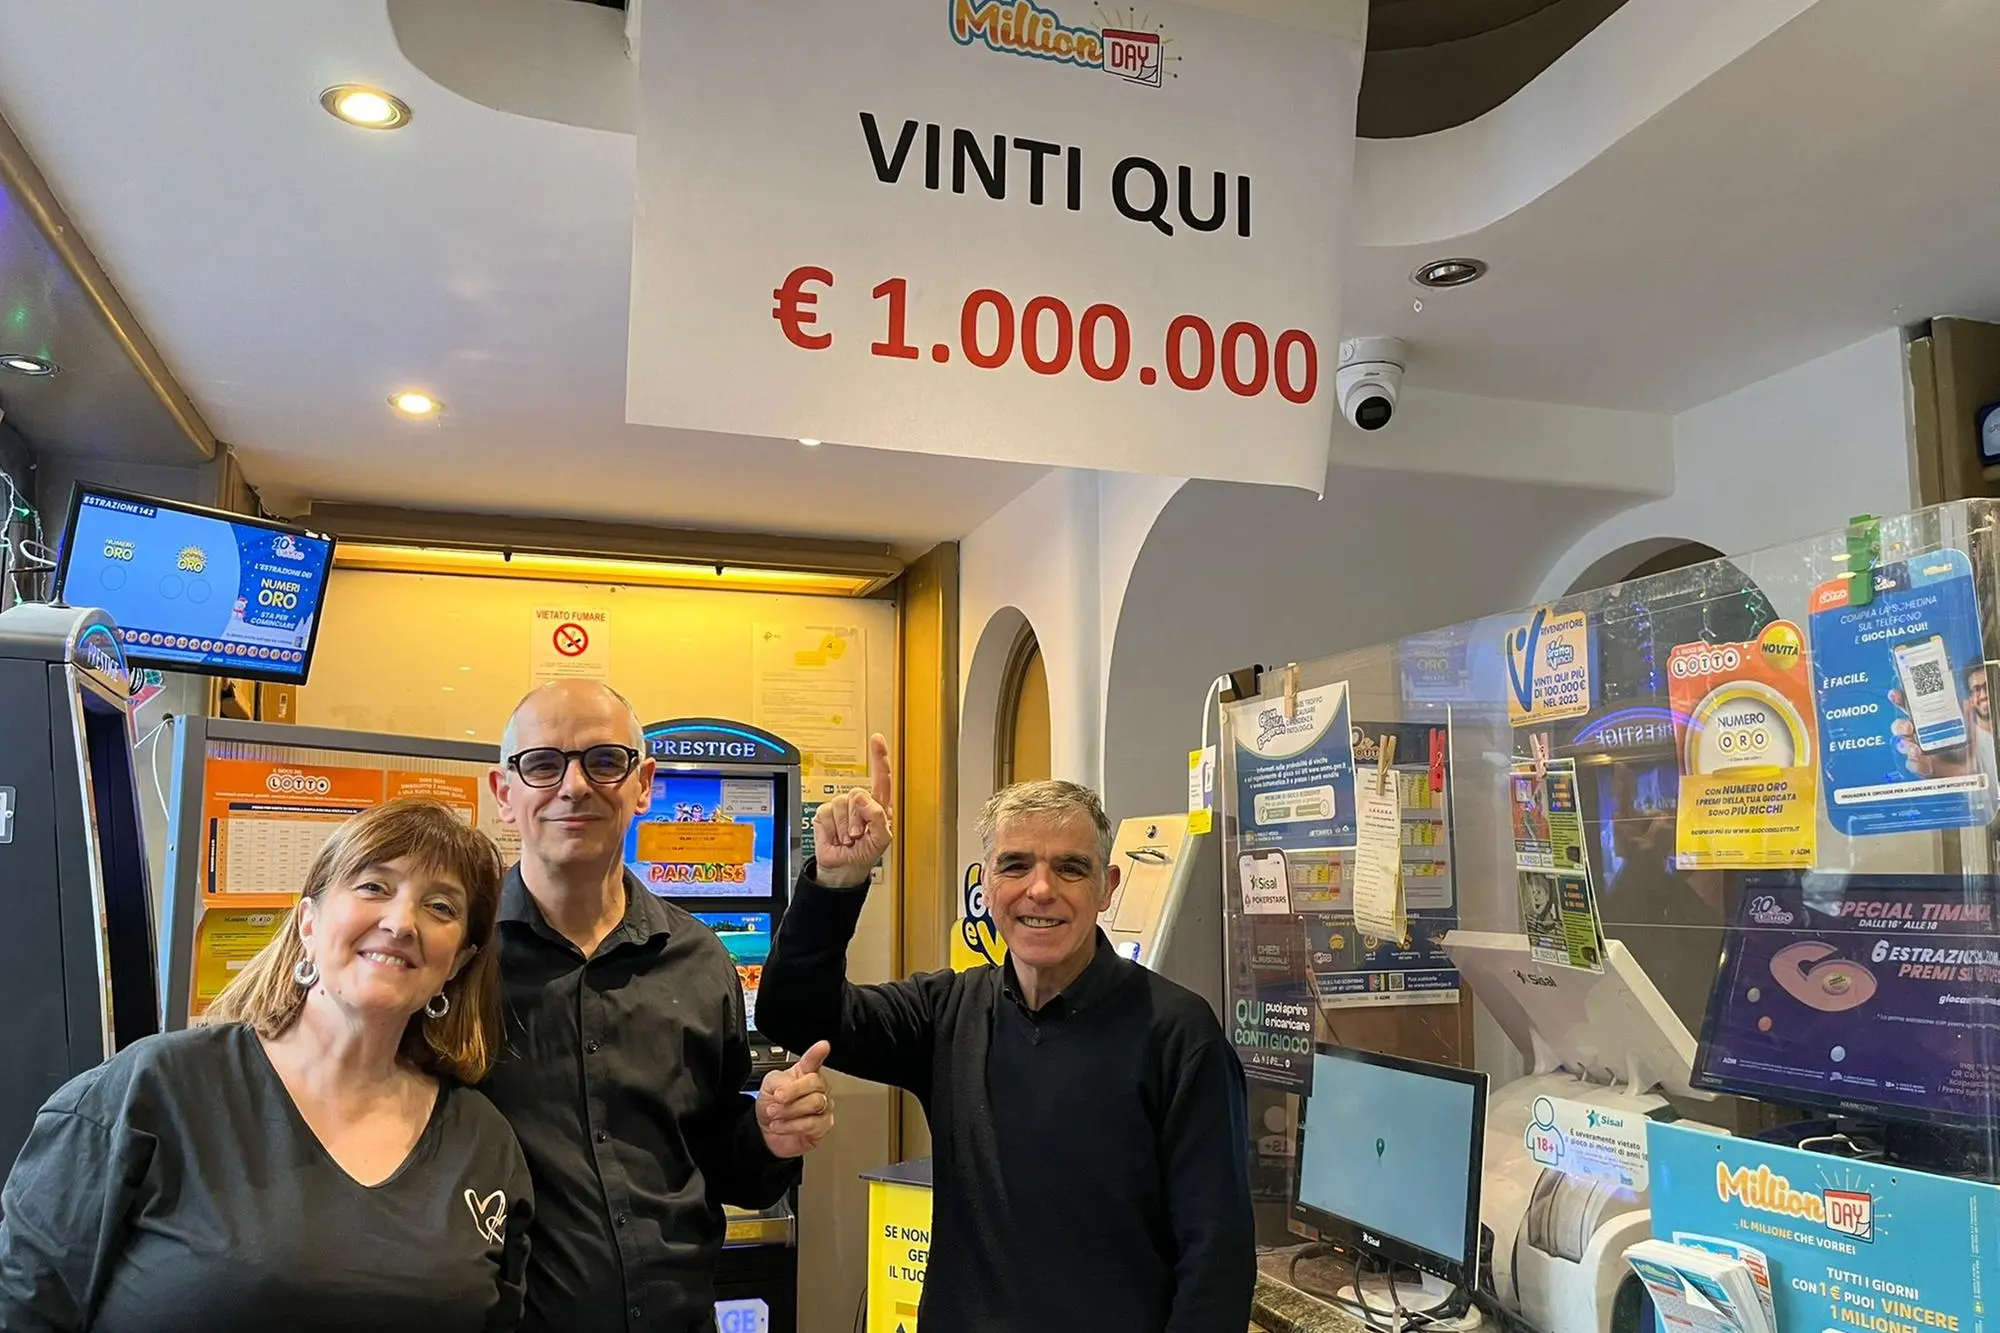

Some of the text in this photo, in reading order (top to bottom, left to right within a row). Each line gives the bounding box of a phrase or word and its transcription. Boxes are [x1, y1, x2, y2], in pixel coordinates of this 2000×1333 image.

[952, 0, 1149, 71] Million DAY
[860, 112, 1252, 238] VINTI QUI
[773, 266, 1318, 405] € 1.000.000
[83, 496, 154, 516] ESTRAZIONE 142
[104, 545, 133, 561] ORO
[178, 560, 203, 573] ORO
[255, 563, 301, 577] L'ESTRAZIONE
[261, 578, 301, 592] NUMERI
[258, 589, 297, 609] ORO
[536, 611, 606, 621] VIETATO FUMARE
[1840, 595, 1937, 625] COMPILA LA SCHEDINA
[250, 618, 296, 630] COMINCIARE
[1541, 619, 1583, 635] RIVENDITORE
[1858, 611, 1922, 632] SUL TELEFONO
[1861, 626, 1906, 642] GIOCALA
[1906, 621, 1929, 634] QUI!
[1761, 641, 1799, 656] NOVITÀ
[88, 642, 119, 682] PRESTIGE
[1673, 650, 1738, 676] LOTTO
[1534, 666, 1585, 687] VINTI QUI PIÙ
[1830, 672, 1869, 688] FACILE,
[1535, 680, 1586, 698] DI 100.000 €
[1544, 694, 1578, 708] NEL 2023
[1718, 712, 1765, 728] NUMERO
[1826, 703, 1878, 720] COMODO
[652, 739, 756, 757] PRESTIGE
[1720, 731, 1767, 752] ORO
[1829, 735, 1885, 752] E VELOCE.
[268, 775, 329, 793] LOTTO
[1705, 781, 1788, 796] CON NUMERO ORO
[1699, 798, 1720, 806] PREMI
[1722, 797, 1744, 805] DELLA
[1746, 796, 1760, 804] TUA
[1762, 793, 1797, 802] GIOCATA
[1731, 804, 1748, 815] PIÙ
[1749, 804, 1783, 815] RICCHI
[650, 864, 746, 883] PARADISE
[1259, 877, 1277, 889] Sisal
[1252, 895, 1286, 904] POKERSTARS
[1750, 896, 1775, 914] 10
[1829, 901, 1913, 919] SPECIAL
[1859, 919, 1887, 928] DALLE
[1904, 921, 1927, 929] ALLE
[1927, 922, 1938, 930] 18
[1871, 939, 1890, 963] 6
[1528, 973, 1557, 988] Sisal
[1898, 964, 1957, 981] PREMI
[1235, 998, 1265, 1028] QUI
[1265, 1002, 1308, 1016] puoi aprire
[1265, 1016, 1310, 1031] e ricaricare
[1235, 1028, 1309, 1054] CONTI GIOCO
[1601, 1116, 1623, 1128] Sisal
[1537, 1136, 1554, 1153] 18+
[1571, 1137, 1588, 1148] gioco
[1596, 1143, 1617, 1155] minori
[1618, 1147, 1624, 1156] di
[1626, 1150, 1640, 1160] anni
[1576, 1130, 1615, 1145] severamente
[1617, 1139, 1640, 1150] vietato
[1717, 1161, 1863, 1229] Million DAY
[885, 1225, 929, 1242] SE NON
[1740, 1218, 1856, 1255] IL MILIONE CHE VORREI
[889, 1266, 925, 1283] IL TUO
[1826, 1266, 1919, 1300] TUTTI I GIORNI
[1792, 1278, 1959, 1331] CON 1 € PUOI VINCERE
[1830, 1304, 1837, 1319] 1
